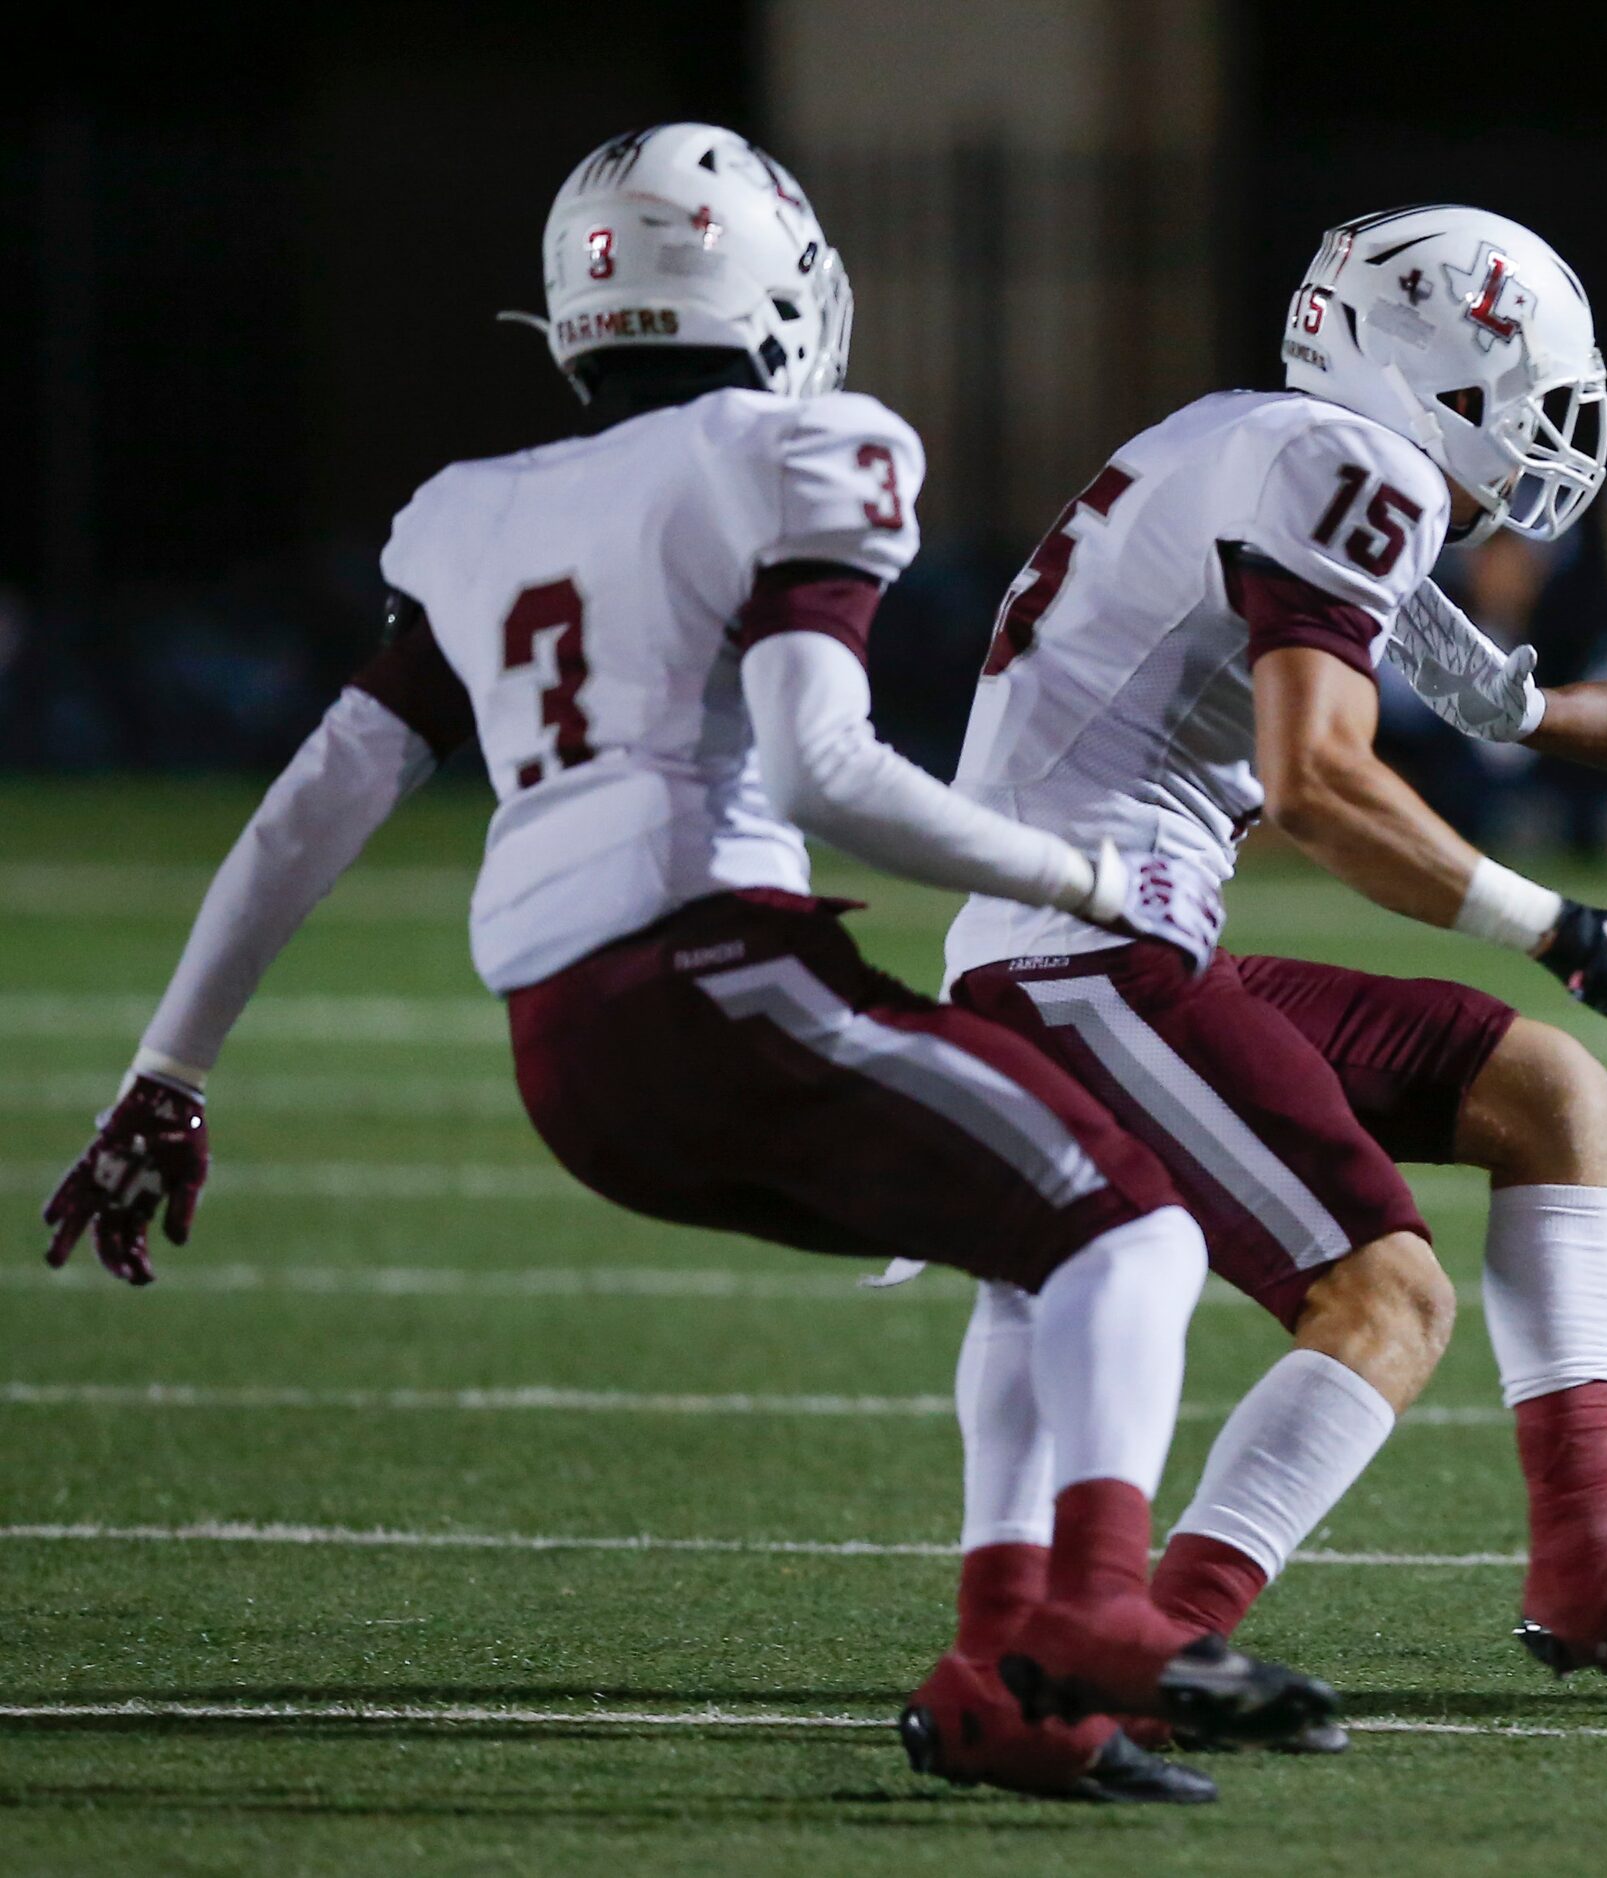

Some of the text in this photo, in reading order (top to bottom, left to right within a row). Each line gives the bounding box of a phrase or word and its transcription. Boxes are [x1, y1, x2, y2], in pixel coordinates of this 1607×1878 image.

[588, 229, 615, 279] 3
[557, 308, 679, 344] FARMERS
[1290, 282, 1335, 335] 15
[857, 443, 905, 530] 3
[1311, 462, 1424, 580] 15
[503, 573, 597, 789] 3
